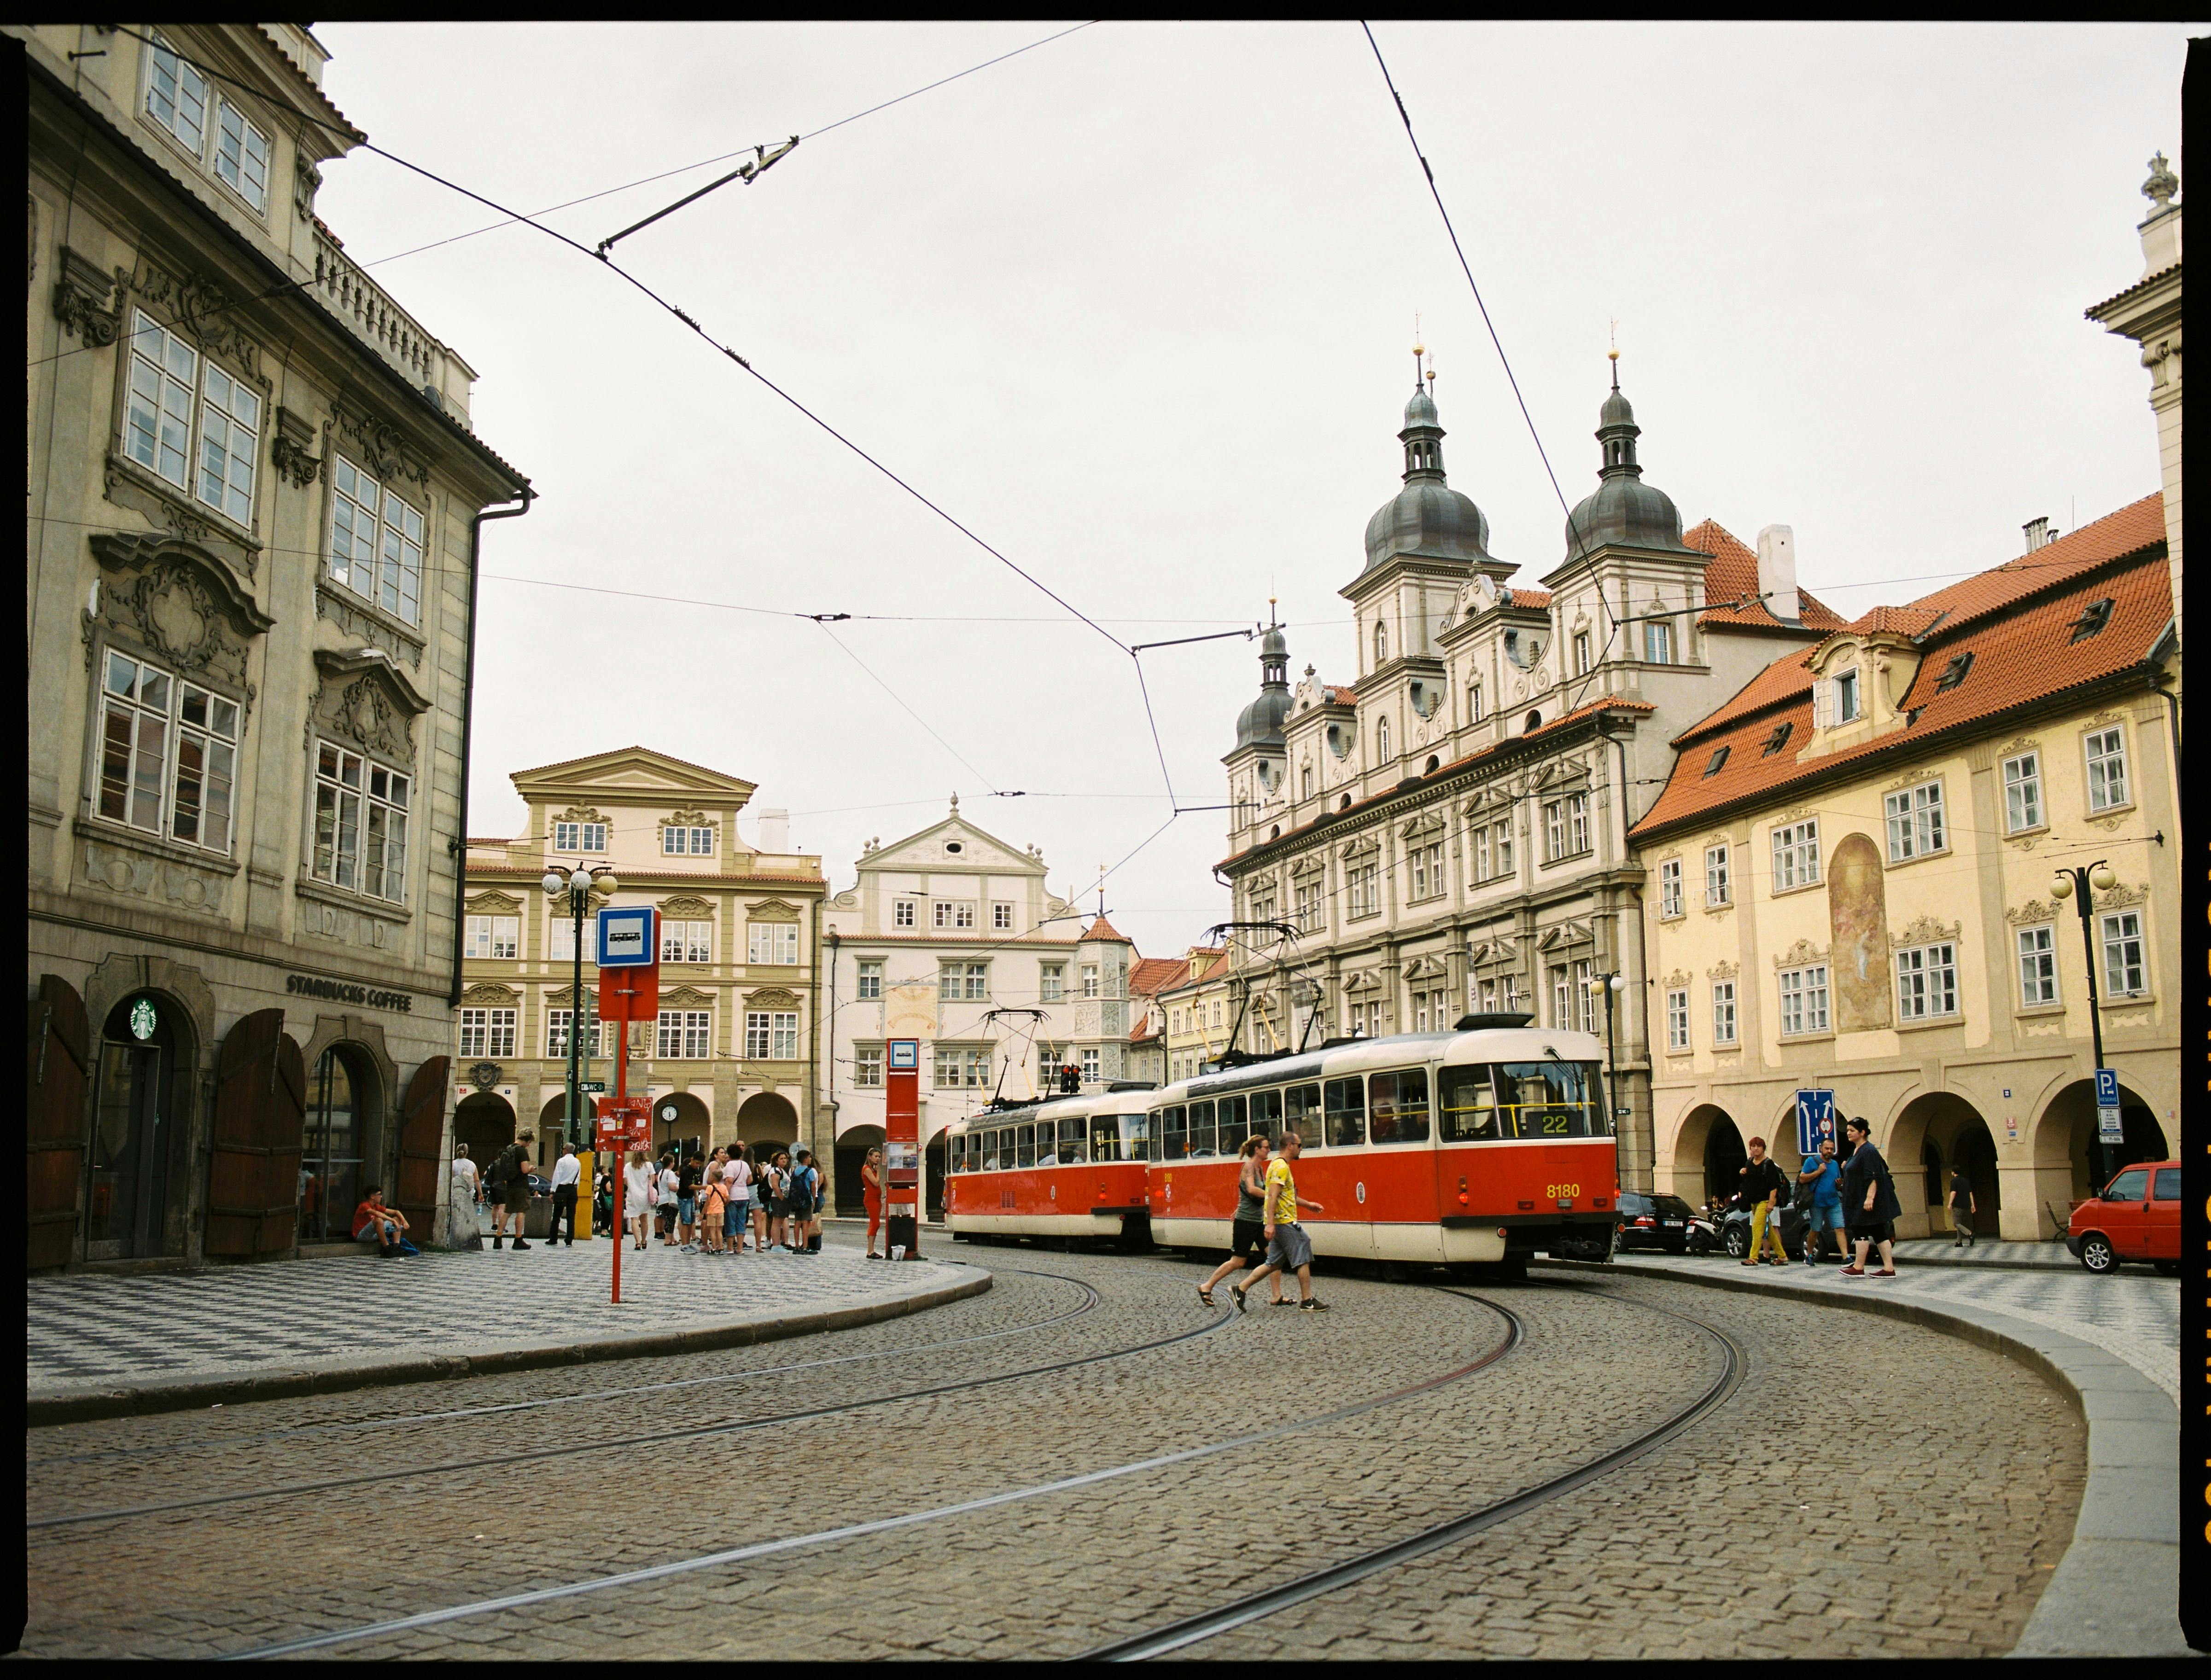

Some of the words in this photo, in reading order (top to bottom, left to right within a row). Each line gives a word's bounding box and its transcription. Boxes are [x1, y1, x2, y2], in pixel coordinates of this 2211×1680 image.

[287, 974, 366, 1004] STARBUCKS
[367, 988, 412, 1011] COFFEE
[1542, 1116, 1568, 1134] 22
[1546, 1184, 1580, 1198] 8180
